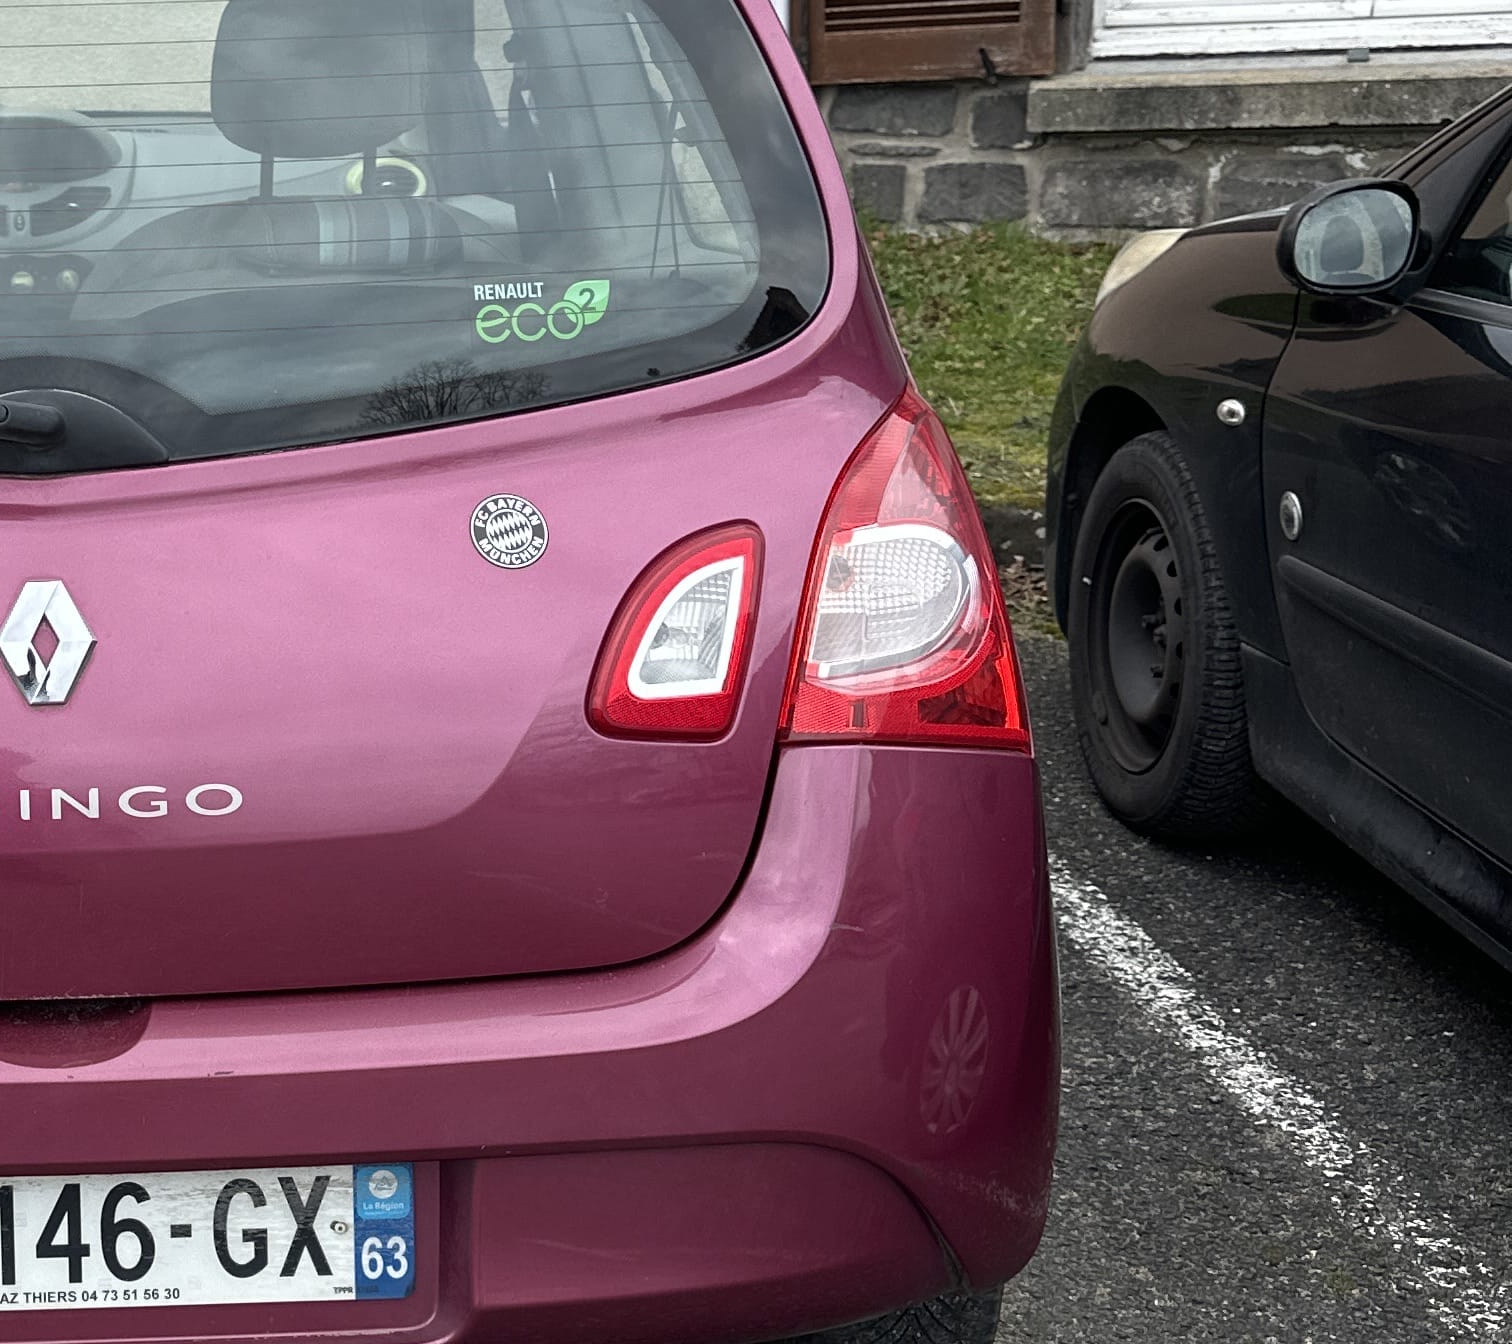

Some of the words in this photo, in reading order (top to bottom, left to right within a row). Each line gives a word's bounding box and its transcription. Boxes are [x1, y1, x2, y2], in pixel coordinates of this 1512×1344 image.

[474, 281, 544, 301] RENAULT
[475, 510, 489, 528] FC
[486, 498, 541, 526] BAYERN
[363, 1202, 373, 1210] La
[361, 1235, 409, 1280] 63
[24, 1291, 77, 1304] THIERS
[81, 1290, 98, 1302] 04
[102, 1289, 119, 1301] 73
[122, 1289, 138, 1301] 51
[143, 1288, 160, 1300] 56
[163, 1287, 180, 1299] 30
